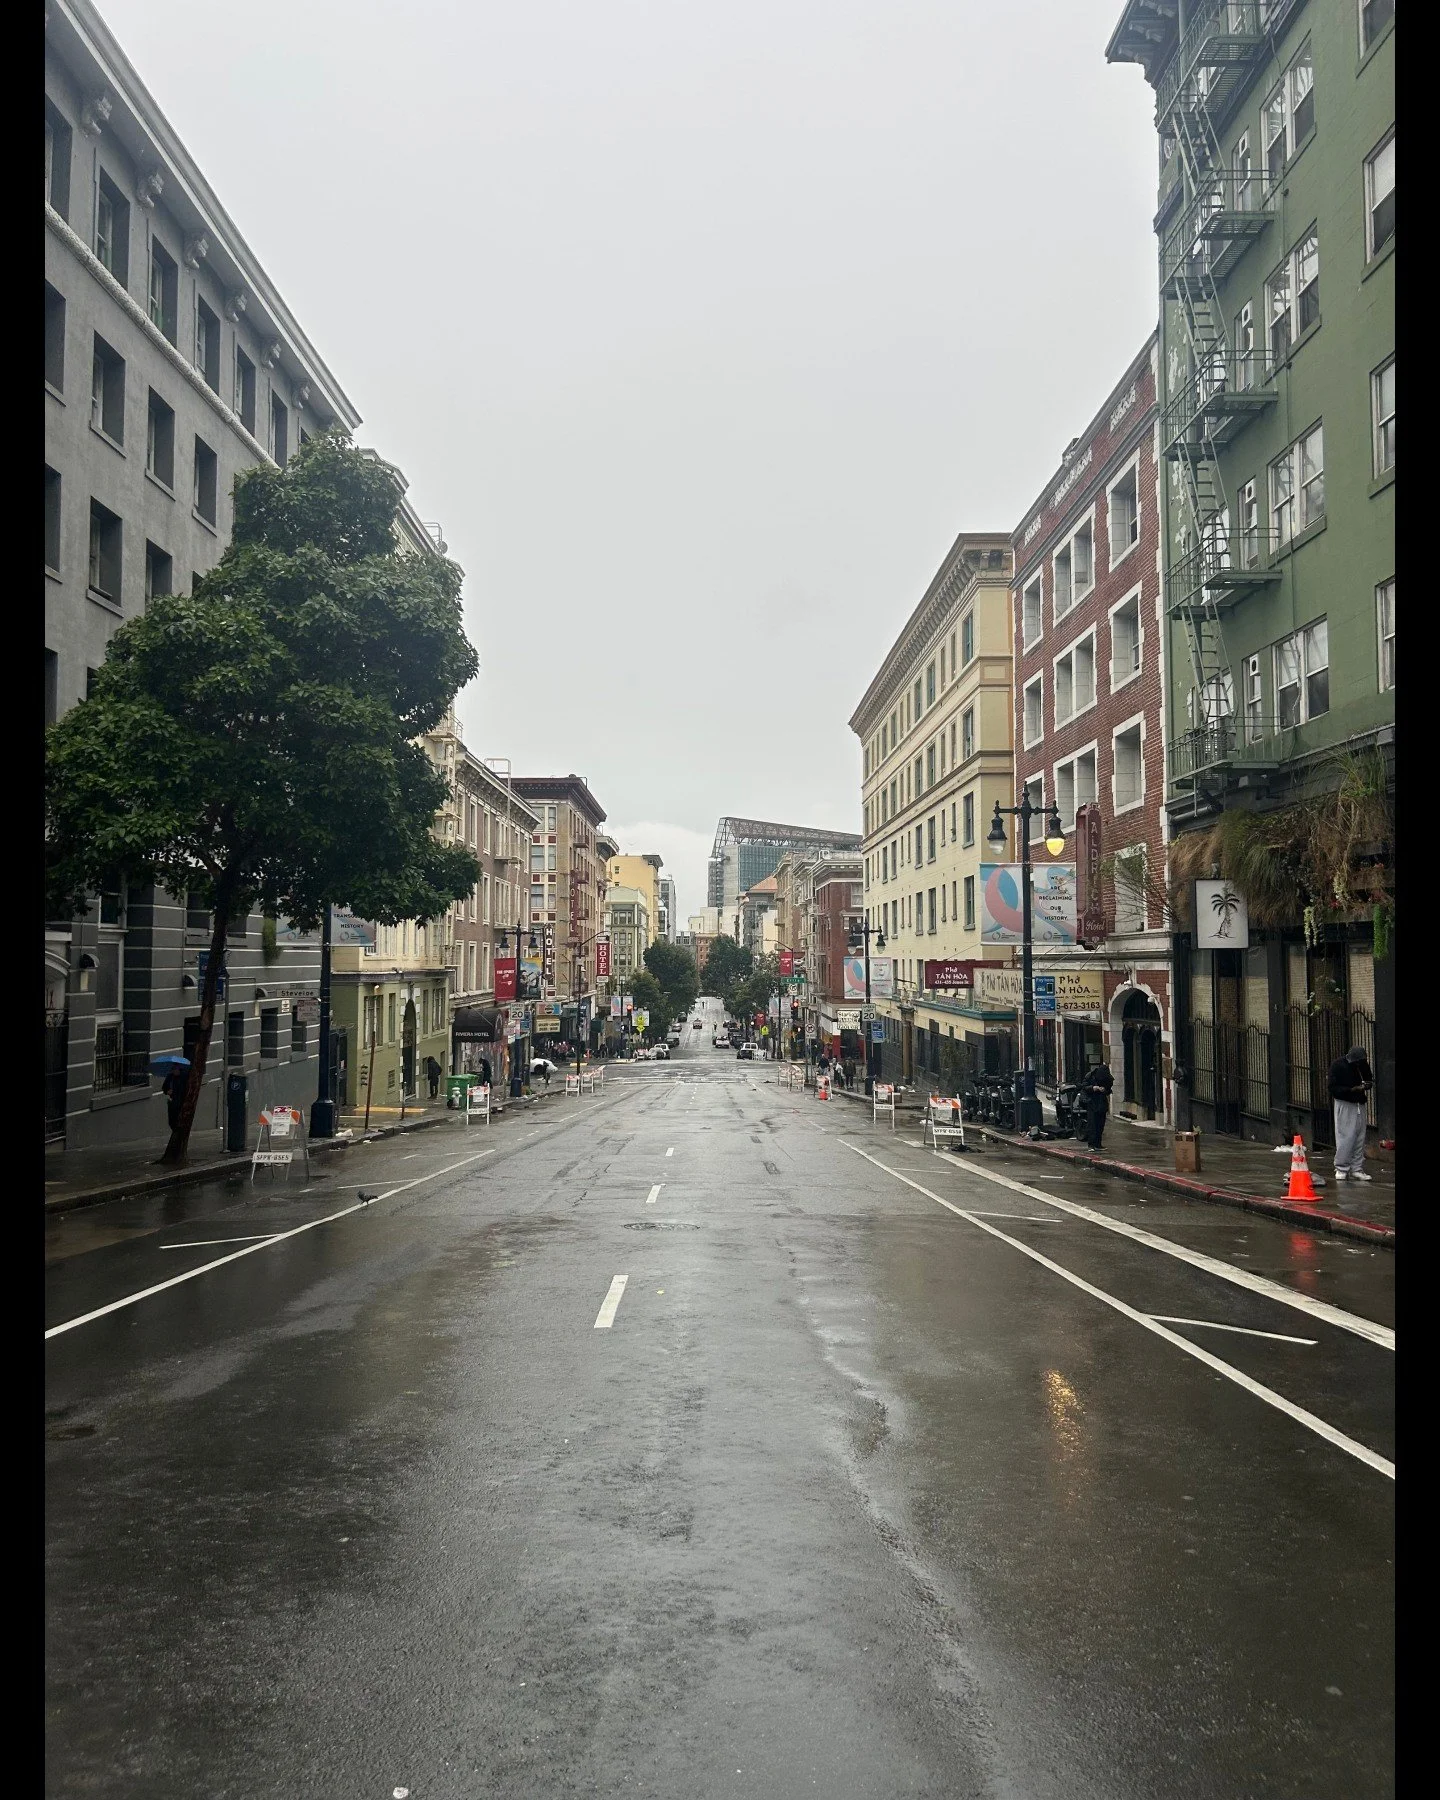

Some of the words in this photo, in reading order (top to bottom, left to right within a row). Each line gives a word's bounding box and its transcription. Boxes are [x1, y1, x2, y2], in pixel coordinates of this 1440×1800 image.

[1085, 920, 1106, 931] Hotel
[545, 928, 553, 975] HOTEL
[599, 944, 607, 975] HOTEL
